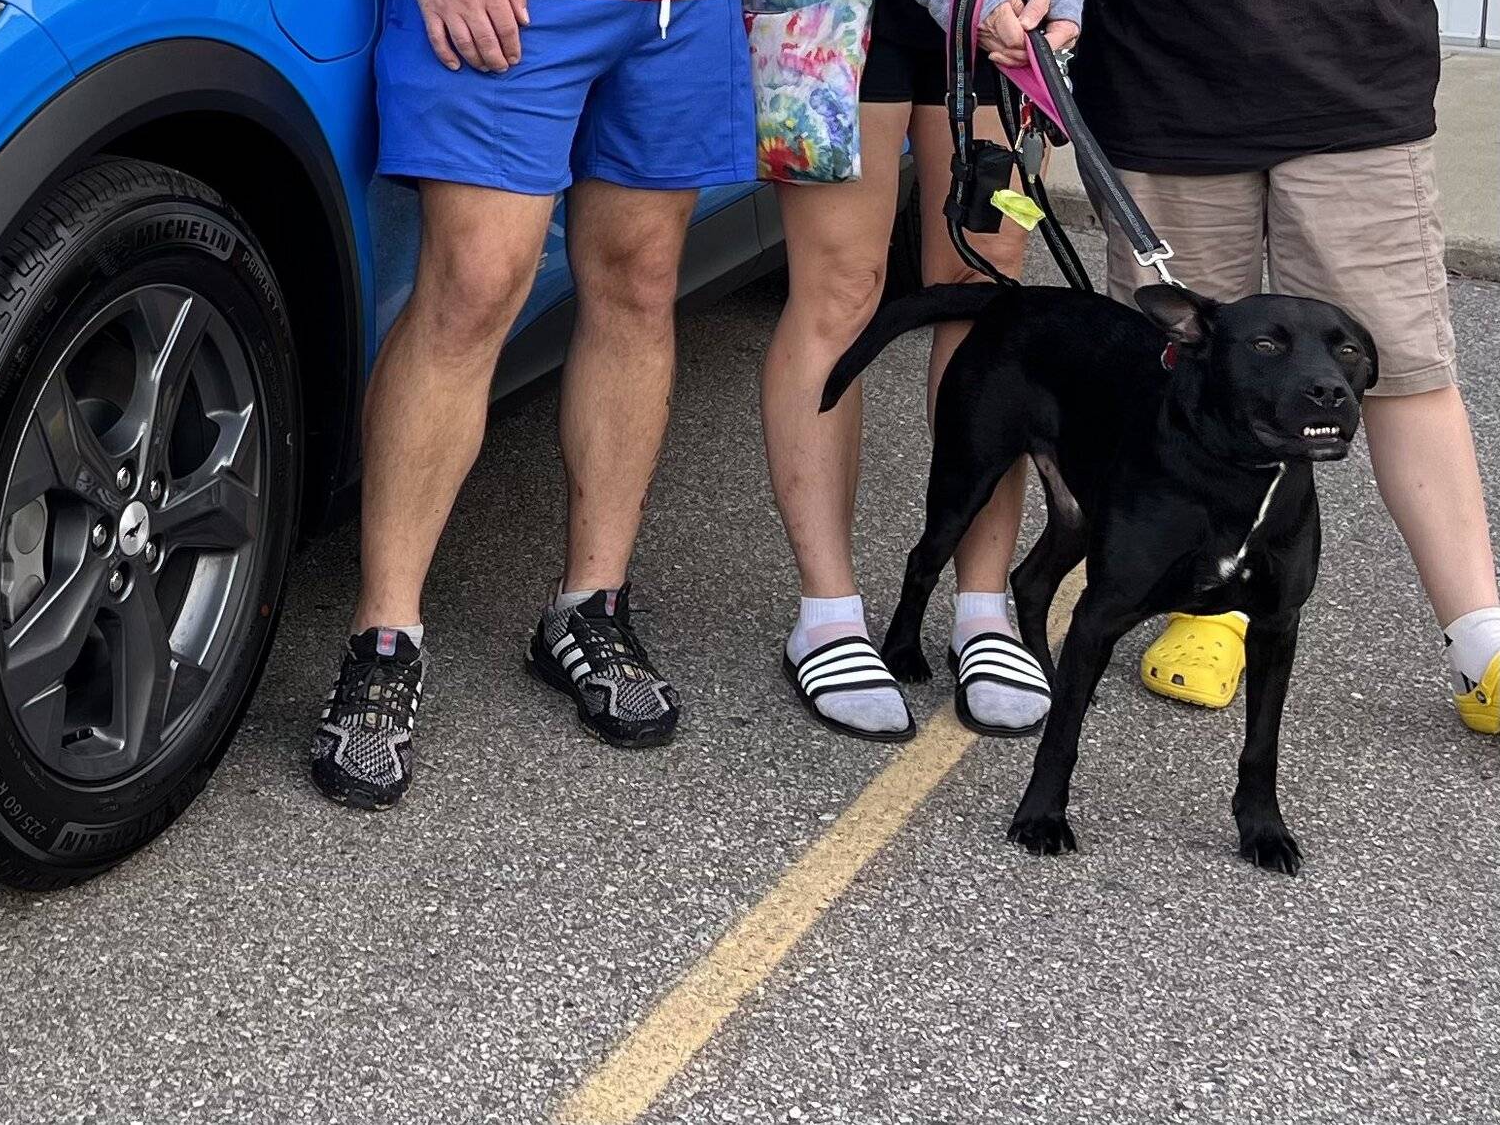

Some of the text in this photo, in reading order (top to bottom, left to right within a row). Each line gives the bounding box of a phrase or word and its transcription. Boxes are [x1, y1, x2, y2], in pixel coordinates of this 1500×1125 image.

[135, 218, 232, 254] MICHELIN
[242, 251, 280, 312] PRIMACY
[2, 796, 48, 840] 225/60
